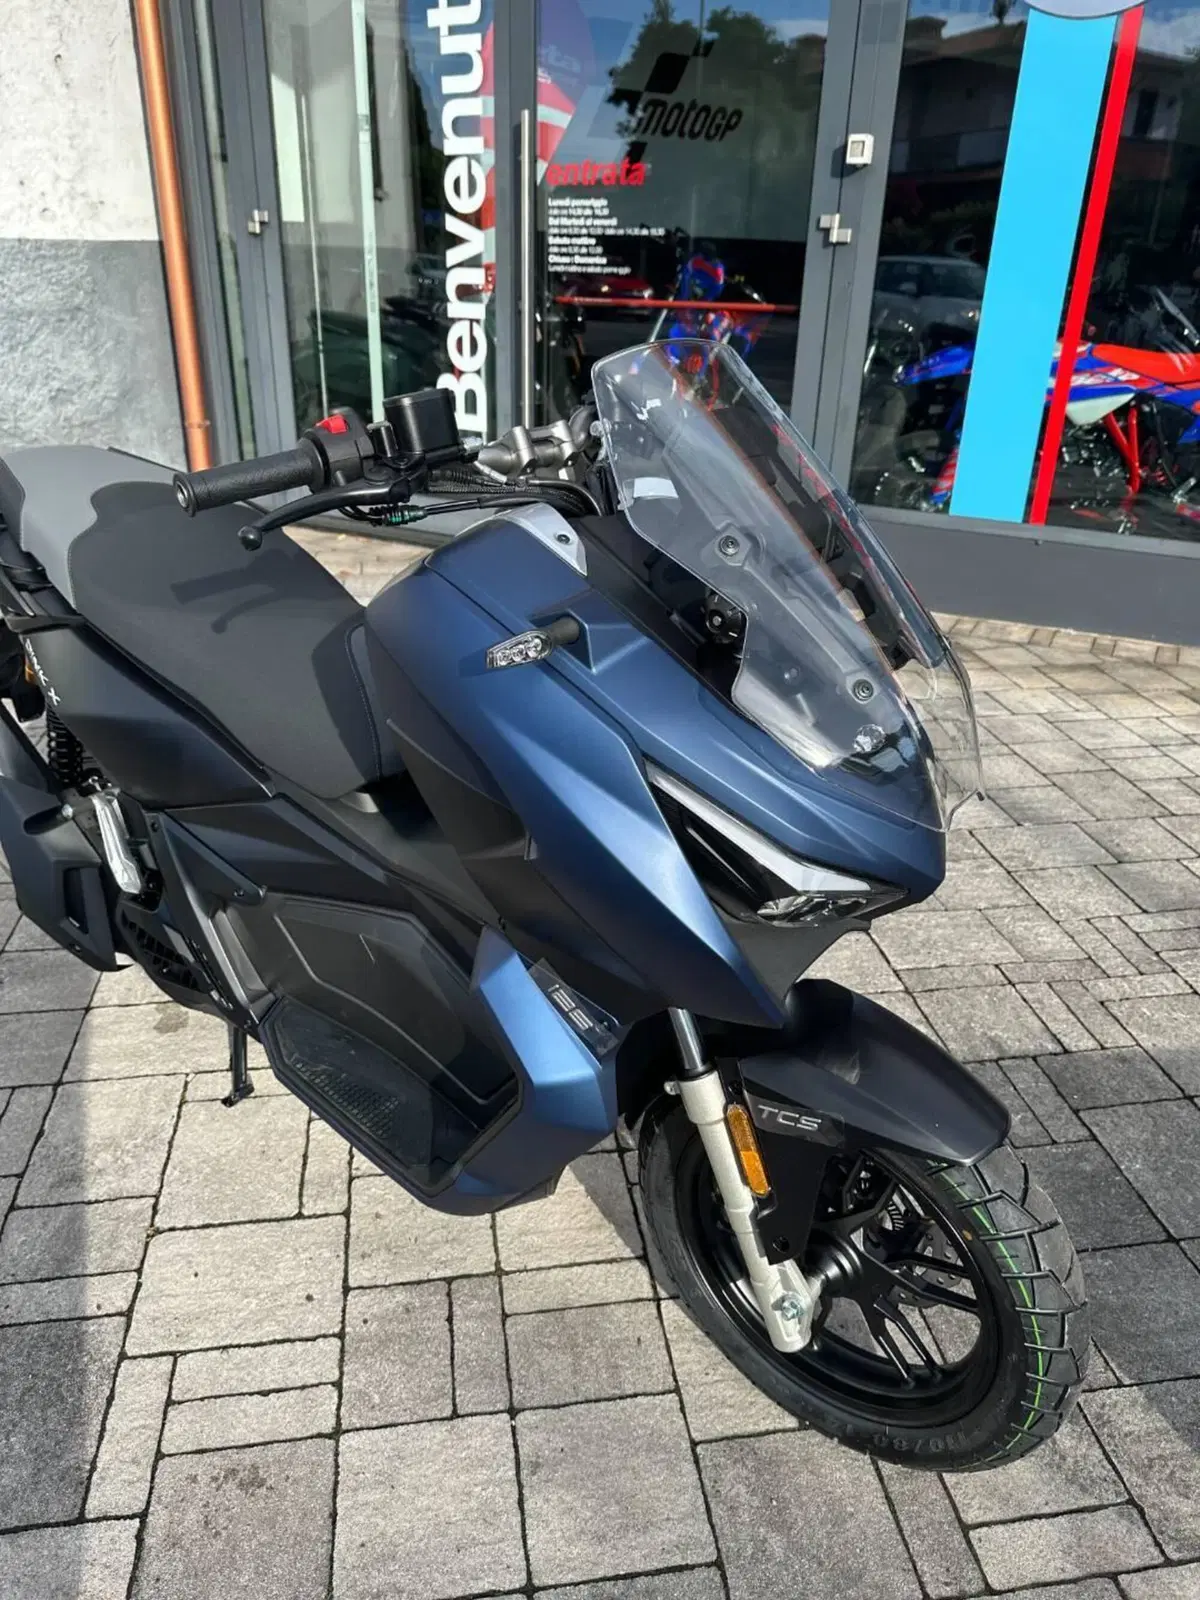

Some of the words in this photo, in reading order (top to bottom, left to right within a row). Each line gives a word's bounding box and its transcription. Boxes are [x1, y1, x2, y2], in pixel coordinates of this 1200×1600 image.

[545, 158, 647, 186] entrata
[47, 687, 61, 706] X
[757, 1104, 822, 1131] TCS
